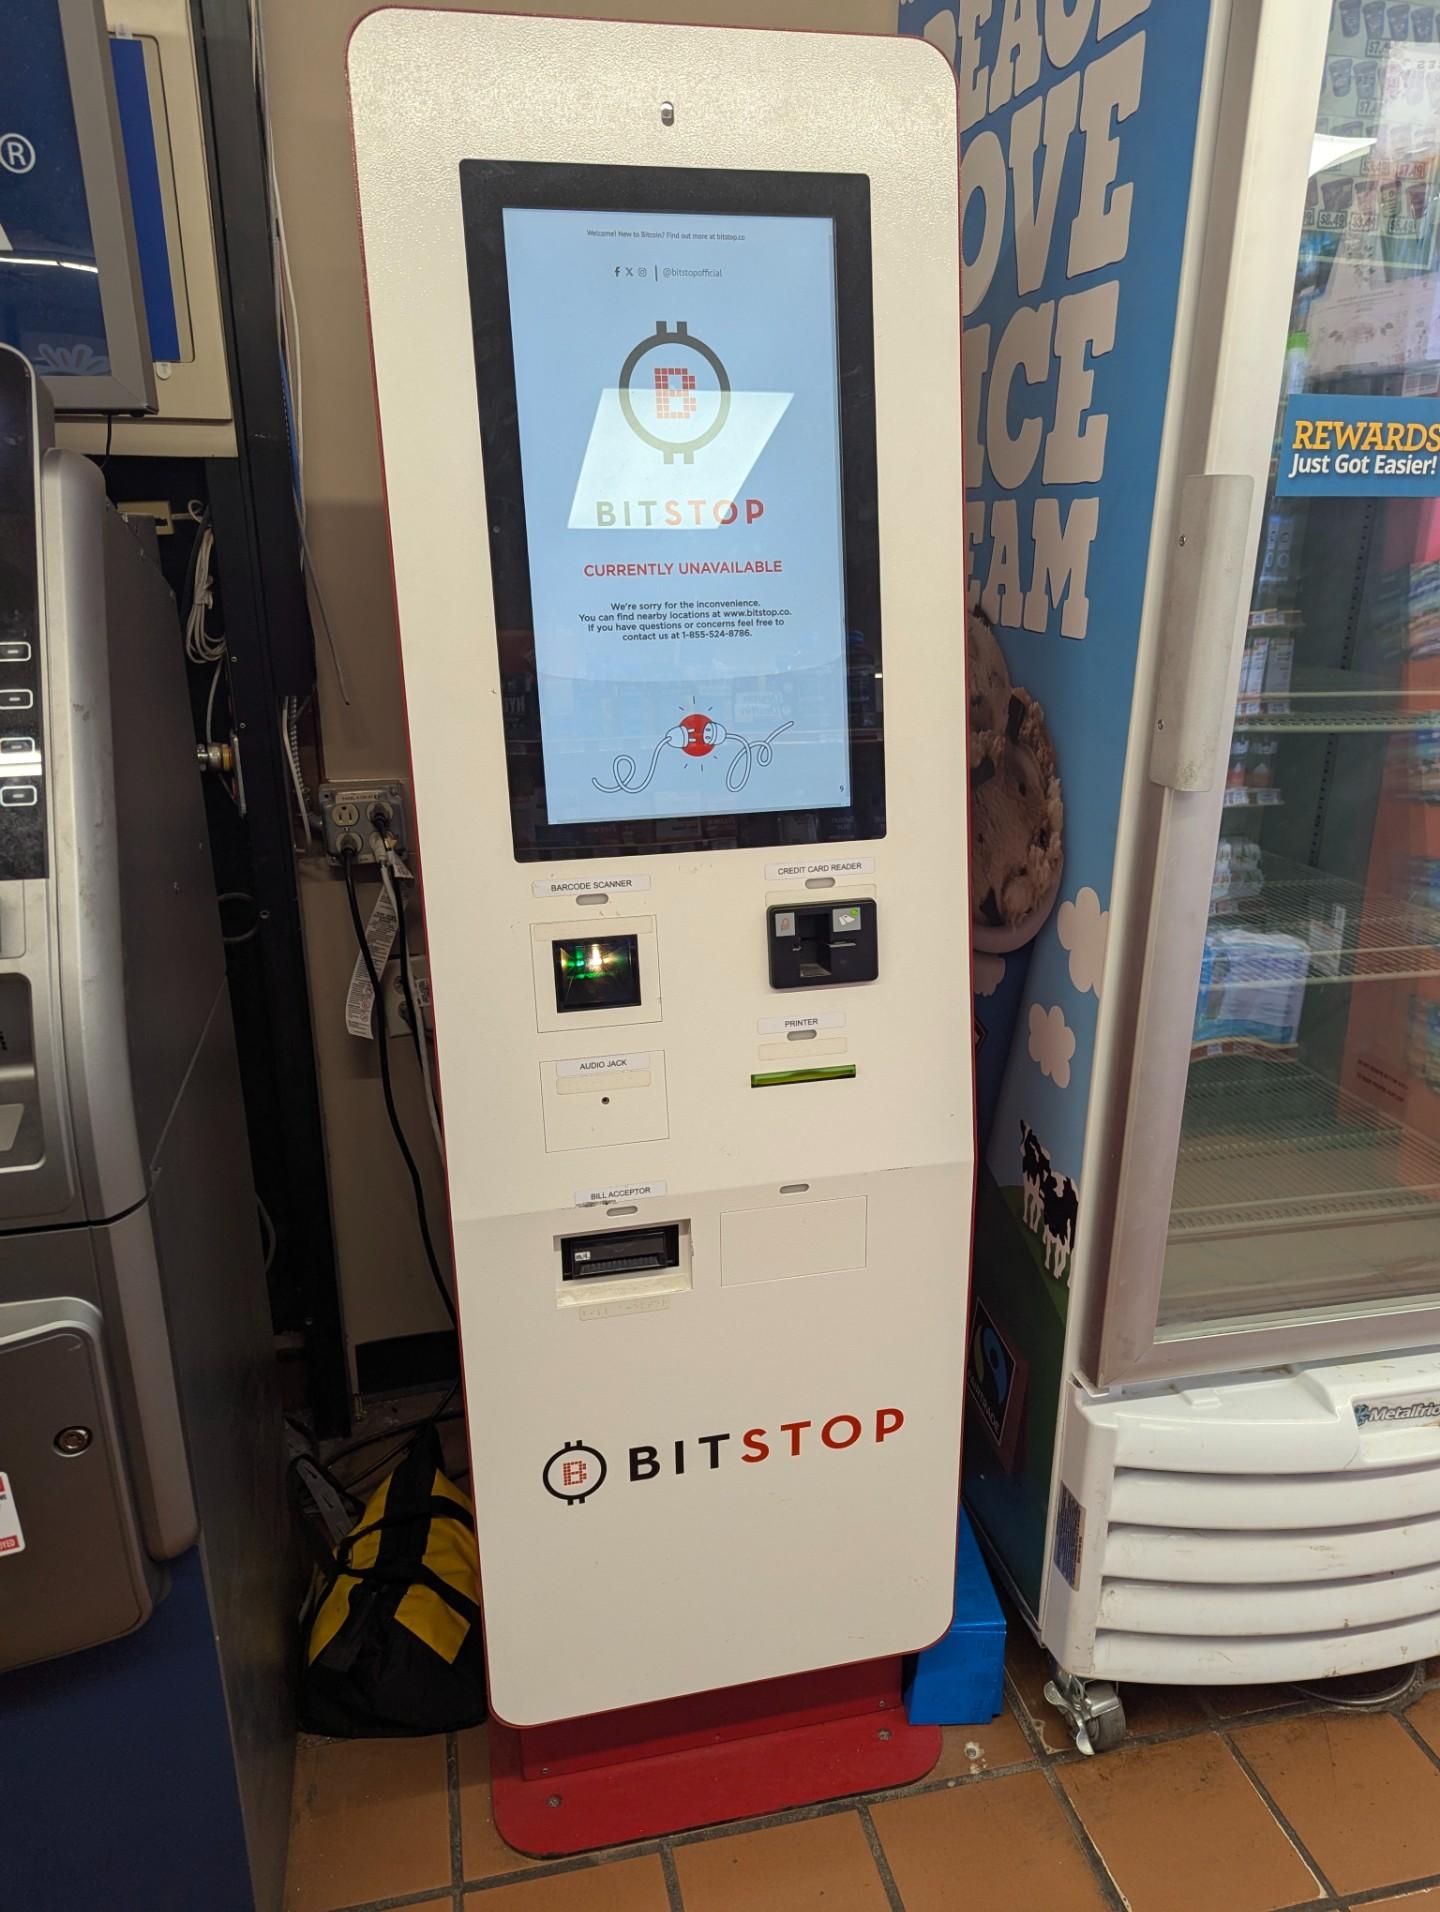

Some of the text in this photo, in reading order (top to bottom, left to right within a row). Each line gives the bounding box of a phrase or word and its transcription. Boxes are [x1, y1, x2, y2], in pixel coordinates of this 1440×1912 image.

[959, 30, 1146, 317] OVE
[633, 231, 640, 239] to
[681, 232, 691, 240] out
[692, 233, 708, 241] more
[709, 234, 716, 242] at
[662, 267, 723, 278] @bitstopofficial
[1292, 420, 1440, 452] REWARDS
[1288, 453, 1438, 478] Just Got Easier!
[596, 499, 764, 527] BITSTOP
[584, 560, 783, 577] CURRENTLY UNAVAILABLE
[610, 600, 761, 611] We're sorry for the inconvenience.
[578, 613, 596, 622] You
[598, 614, 614, 622] can
[616, 612, 634, 621] find
[636, 611, 667, 620] nearby
[669, 610, 710, 619] locations
[723, 609, 792, 617] www.bitstop.co.
[587, 623, 595, 632] If
[597, 625, 613, 633] you
[615, 623, 637, 631] have
[639, 622, 682, 631] questions
[696, 620, 735, 628] concerns
[737, 618, 754, 627] feel
[755, 618, 773, 626] free
[775, 618, 785, 626] to
[622, 629, 753, 641] contact us at 1-855-524-8786.
[777, 862, 862, 876] CREDIT CARD READER
[550, 879, 632, 892] BARCODE SCANNER
[784, 1018, 818, 1028] PRINTER
[579, 1058, 627, 1069] AUDIO JACK
[590, 1186, 651, 1200] BILL ACCEPTOR
[628, 1407, 905, 1482] BITSTOP
